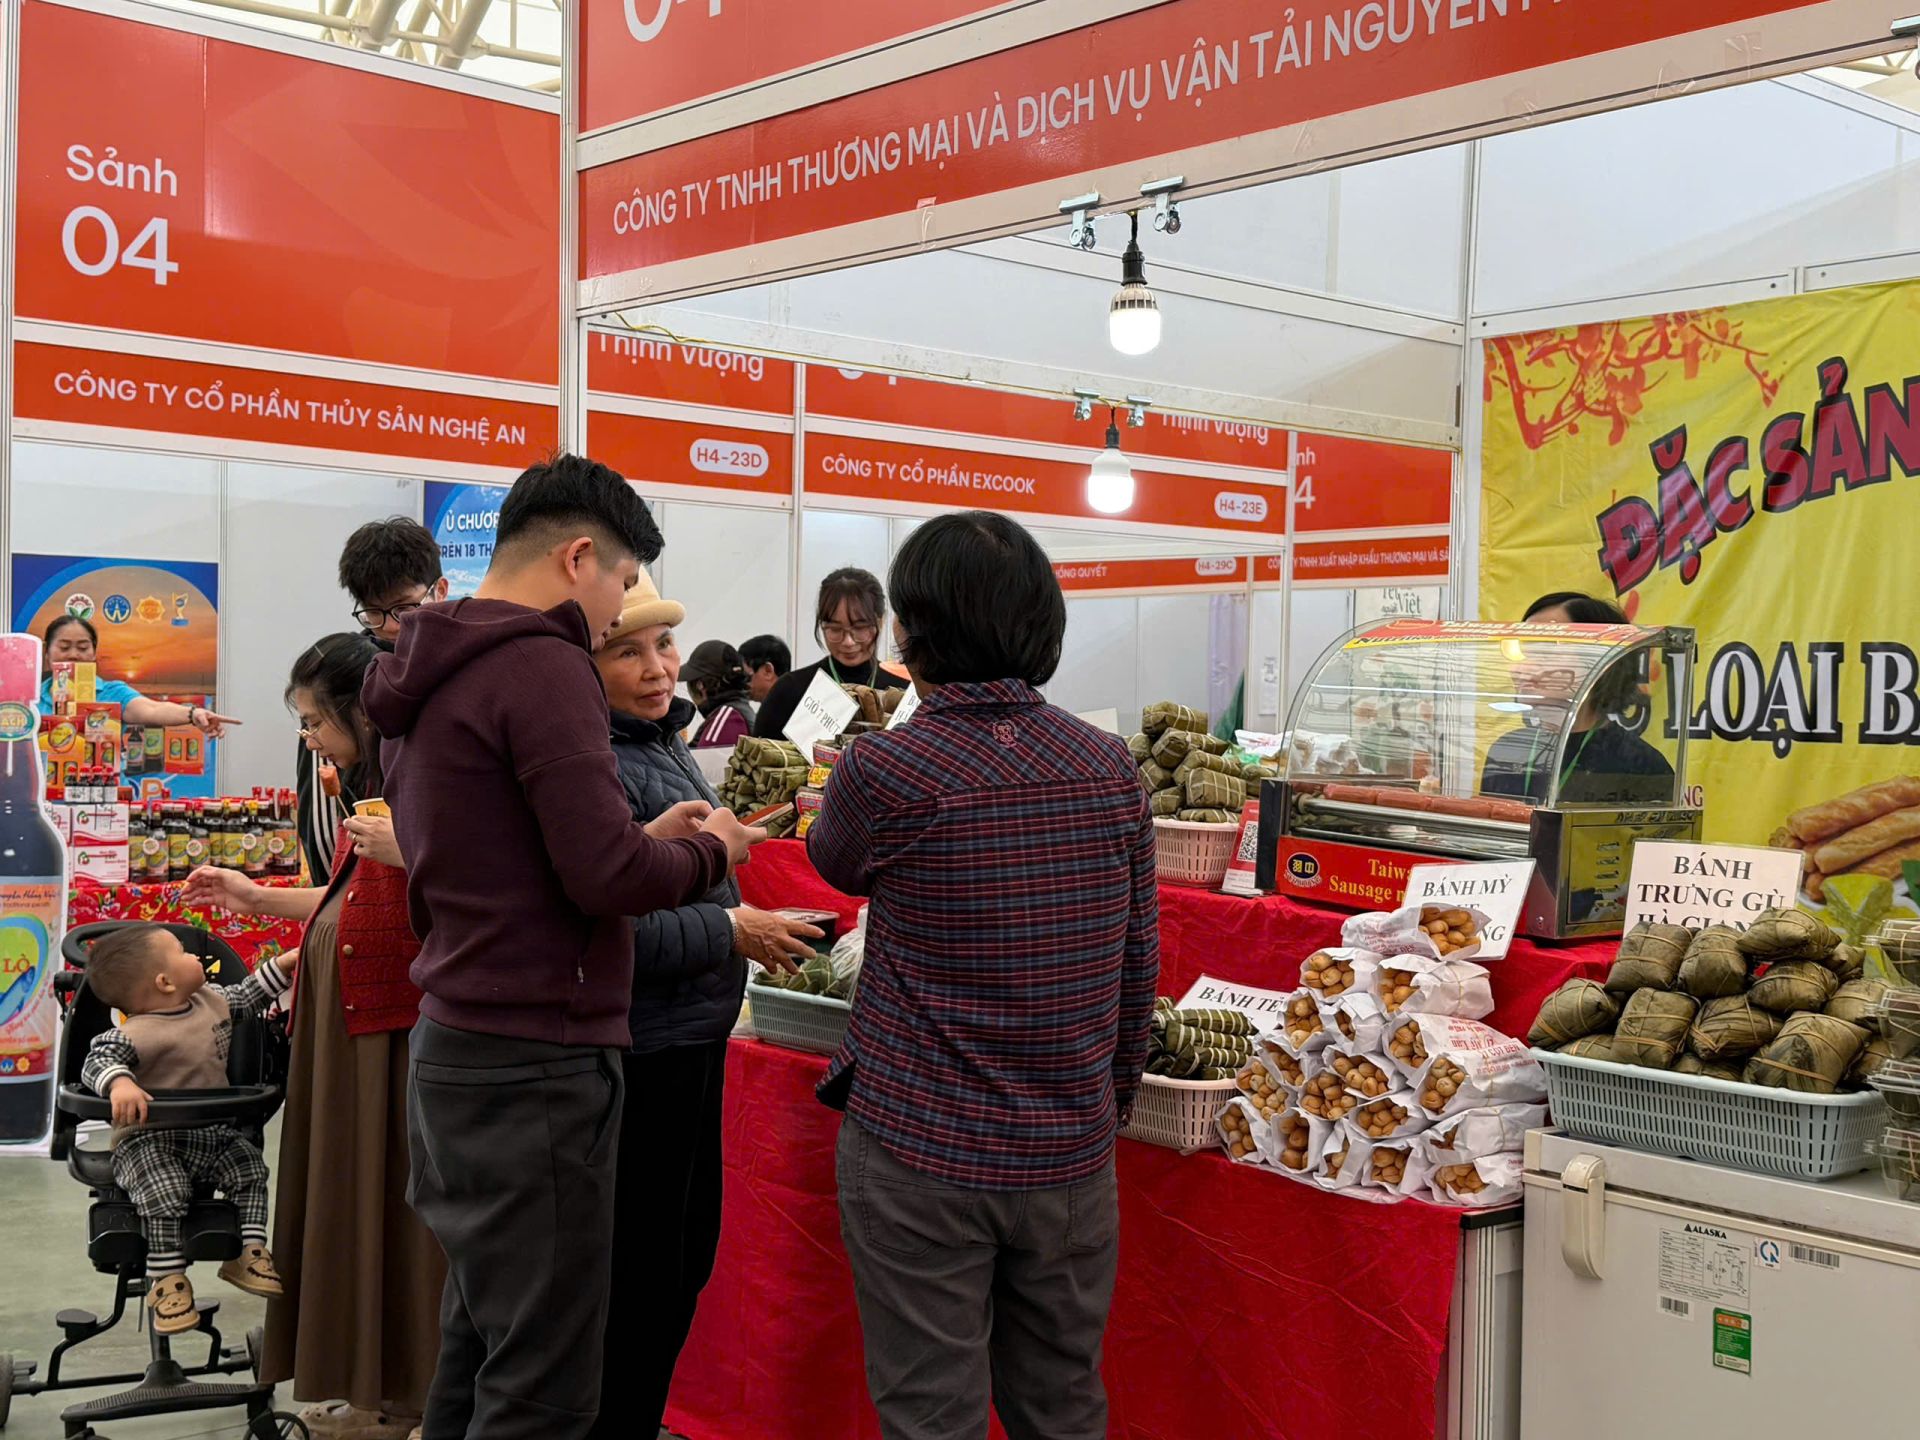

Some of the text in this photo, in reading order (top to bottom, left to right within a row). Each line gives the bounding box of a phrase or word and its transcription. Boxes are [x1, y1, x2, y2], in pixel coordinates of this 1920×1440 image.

[614, 188, 676, 234] CÔNG
[682, 180, 710, 218] TY
[717, 162, 781, 210] TNHH
[788, 132, 900, 193] THƯƠNG
[909, 115, 958, 169] MẠI
[967, 92, 1009, 149] VÀ
[1018, 79, 1094, 145] DỊCH
[1104, 64, 1150, 121] VỤ
[1161, 37, 1238, 107] VẬN
[1250, 8, 1311, 78] TẢI
[66, 144, 178, 196] Sảnh
[62, 205, 179, 285] 04
[55, 369, 525, 445] CÔNG TY CỔ PHẦN THỦY SẢN NGHỆ AN
[696, 447, 762, 469] H4-23D
[823, 453, 1034, 494] CÔNG TY CỔ PHẦN EXCOOK
[1596, 356, 1920, 596] ĐẶC SẢN
[1294, 475, 1316, 510] 4
[1219, 498, 1262, 516] H4-23E
[441, 541, 462, 558] RÊN
[465, 544, 475, 558] 18
[1300, 557, 1317, 567] TNHH
[1318, 552, 1338, 567] XUẤT
[1381, 551, 1411, 564] THƯƠNG
[1412, 551, 1426, 565] MẠI
[1199, 559, 1233, 571] H4-29C
[1664, 641, 1844, 758] LOẠI
[1858, 642, 1920, 743] B
[1673, 852, 1753, 880] BÁNH
[1329, 875, 1392, 902] Sausage
[1423, 878, 1480, 897] BÁNH
[1479, 874, 1512, 894] MỲ
[1637, 883, 1786, 911] TRƯNG GÙ
[1198, 986, 1255, 1009] BÁNH
[1692, 1225, 1727, 1240] ALASKA
